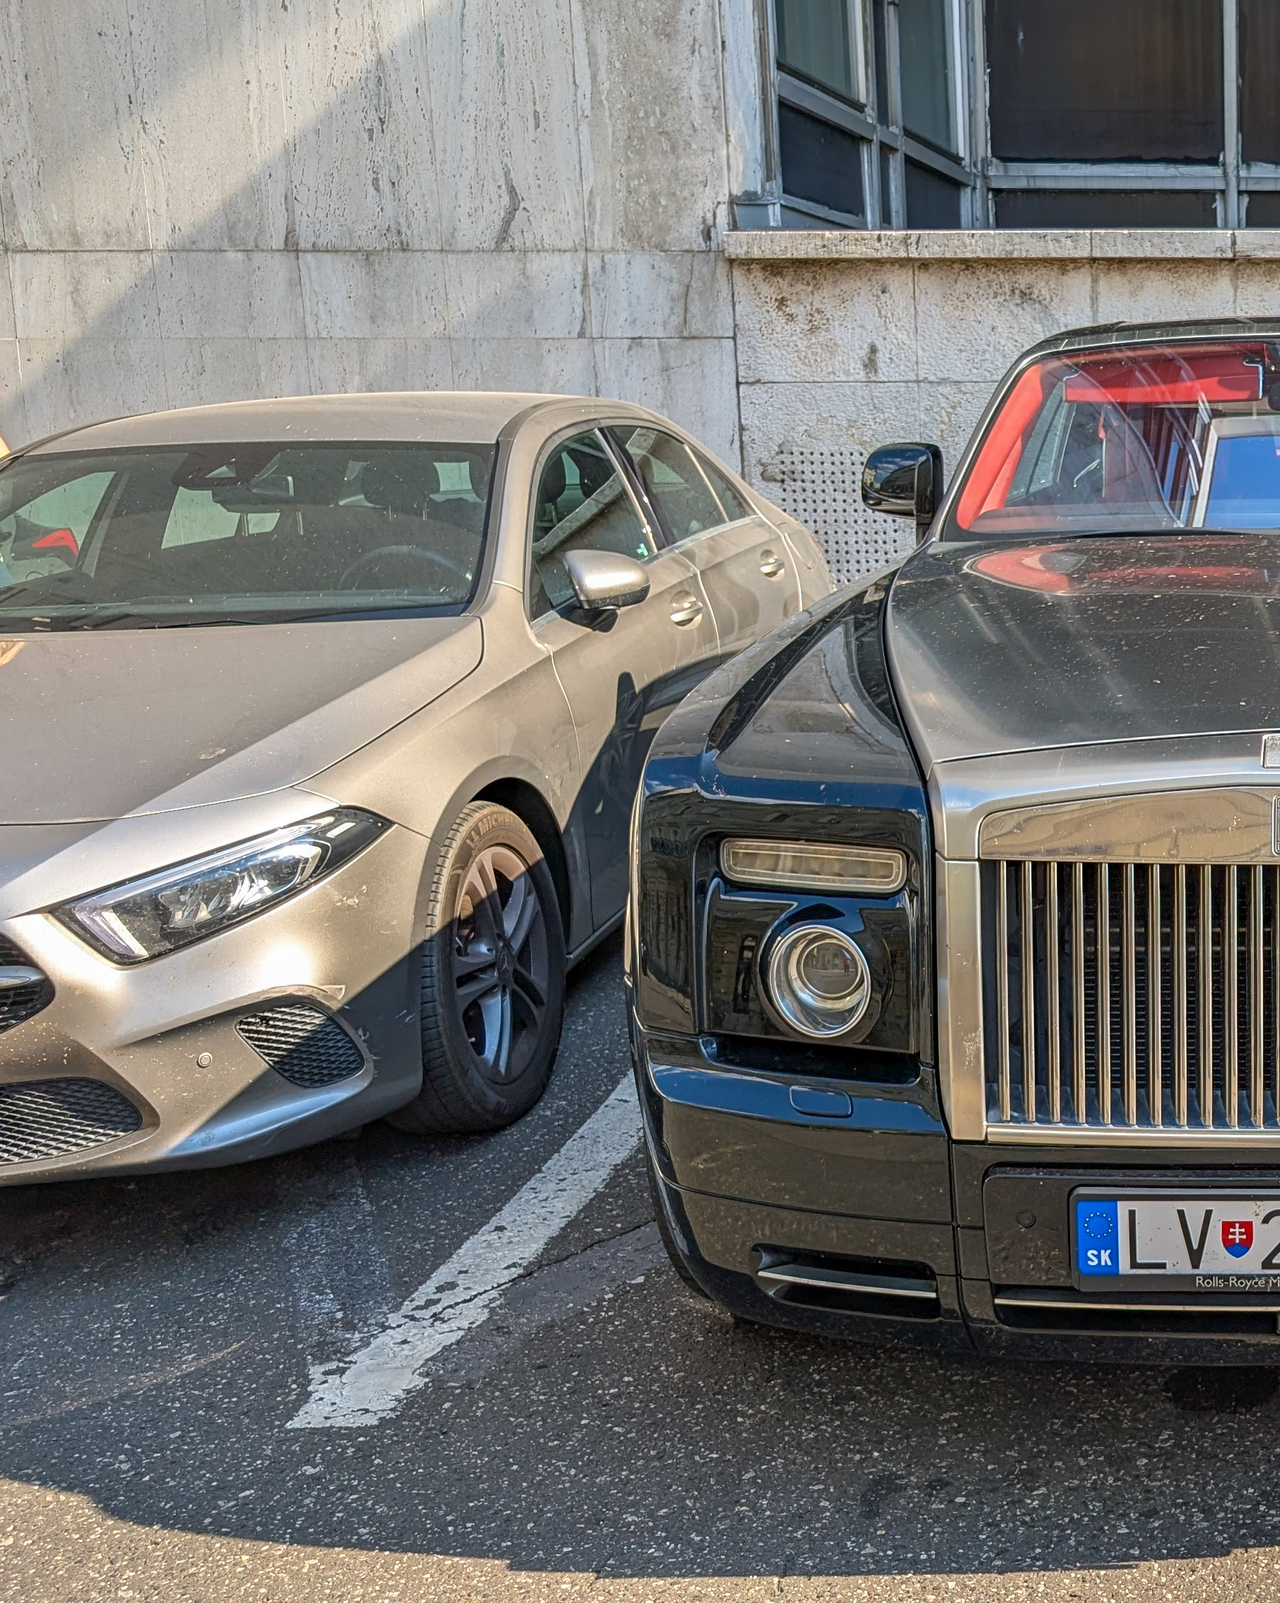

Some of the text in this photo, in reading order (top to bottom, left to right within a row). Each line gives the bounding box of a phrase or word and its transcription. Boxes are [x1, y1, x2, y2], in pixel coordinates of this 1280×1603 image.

[1128, 1207, 1214, 1270] LV
[1087, 1249, 1112, 1266] SK
[1195, 1276, 1266, 1290] Rolls-Royce
